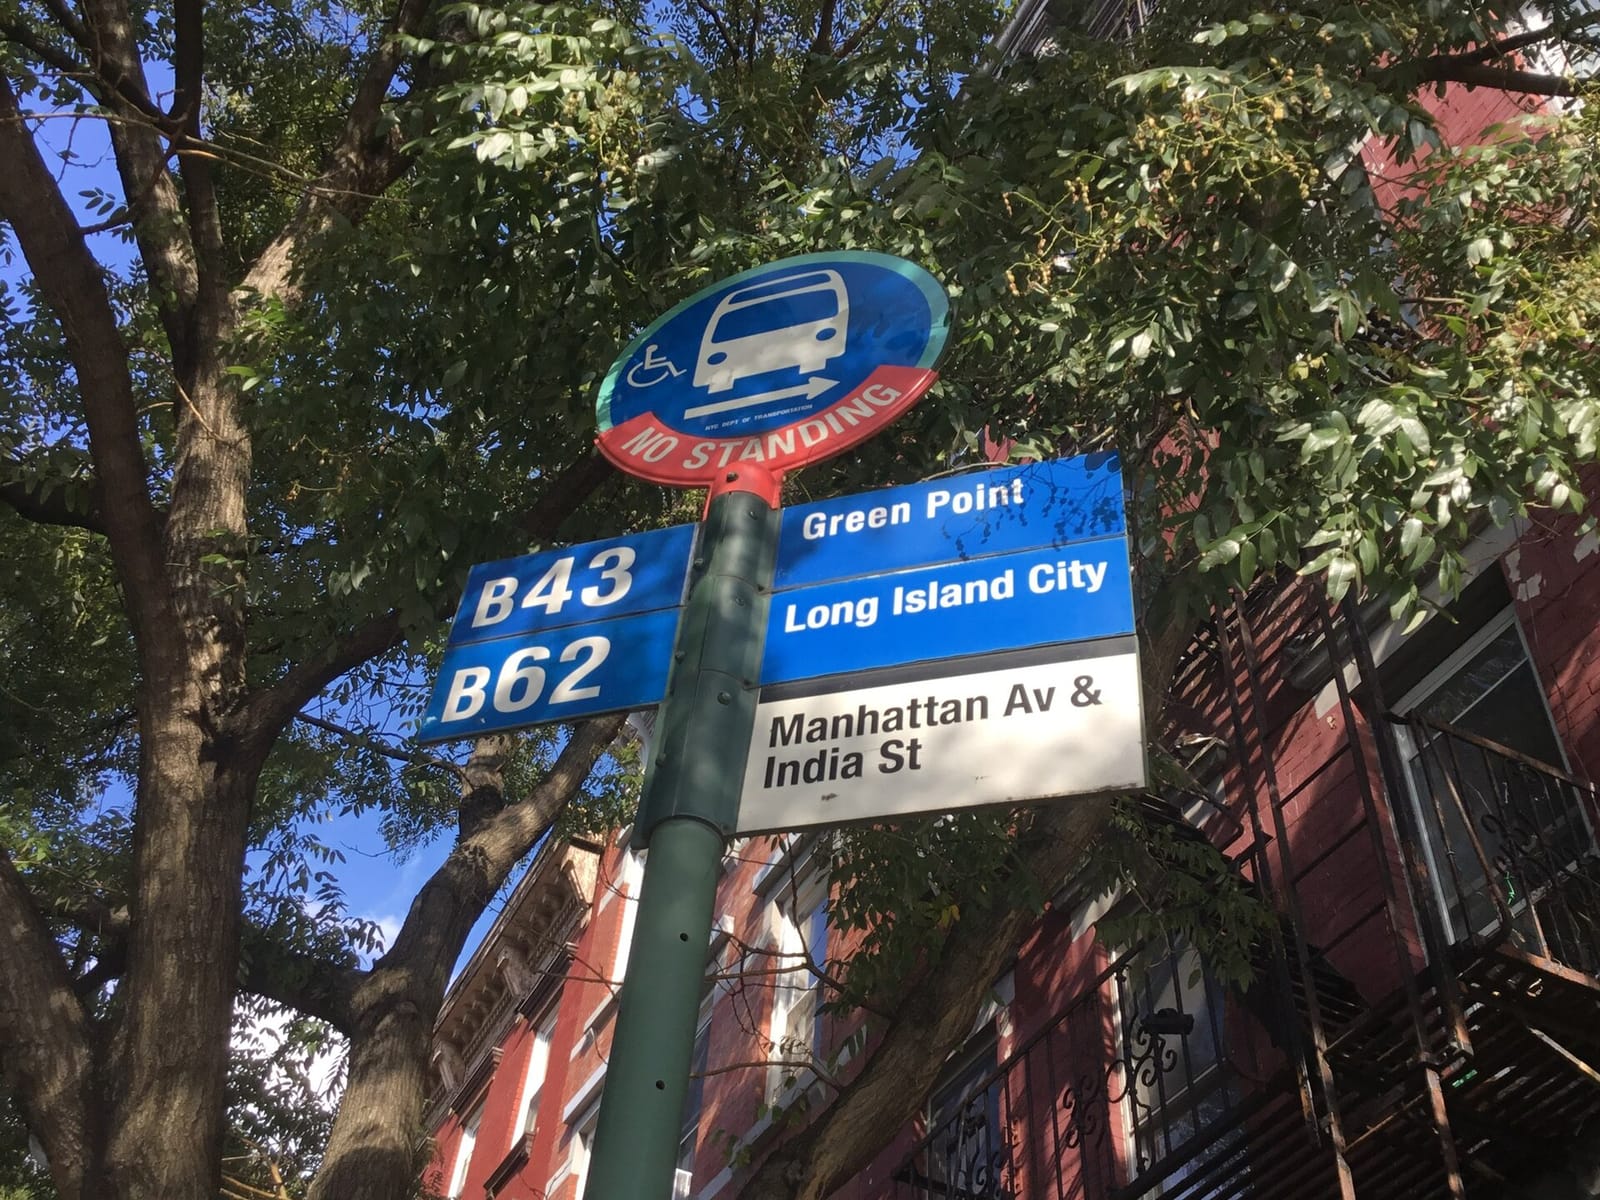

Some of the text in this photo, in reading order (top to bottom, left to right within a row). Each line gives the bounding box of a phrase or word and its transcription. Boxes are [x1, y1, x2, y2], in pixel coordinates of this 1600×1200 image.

[621, 383, 902, 470] NO STANDING
[705, 404, 814, 431] NYC DEPT OF TRANSPORTATION
[802, 477, 1024, 541] Green Point
[471, 546, 636, 628] B43
[784, 558, 1109, 633] Long Island City
[441, 636, 611, 723] B62
[768, 674, 1103, 748] Manhattan Av &
[763, 737, 923, 789] India St
